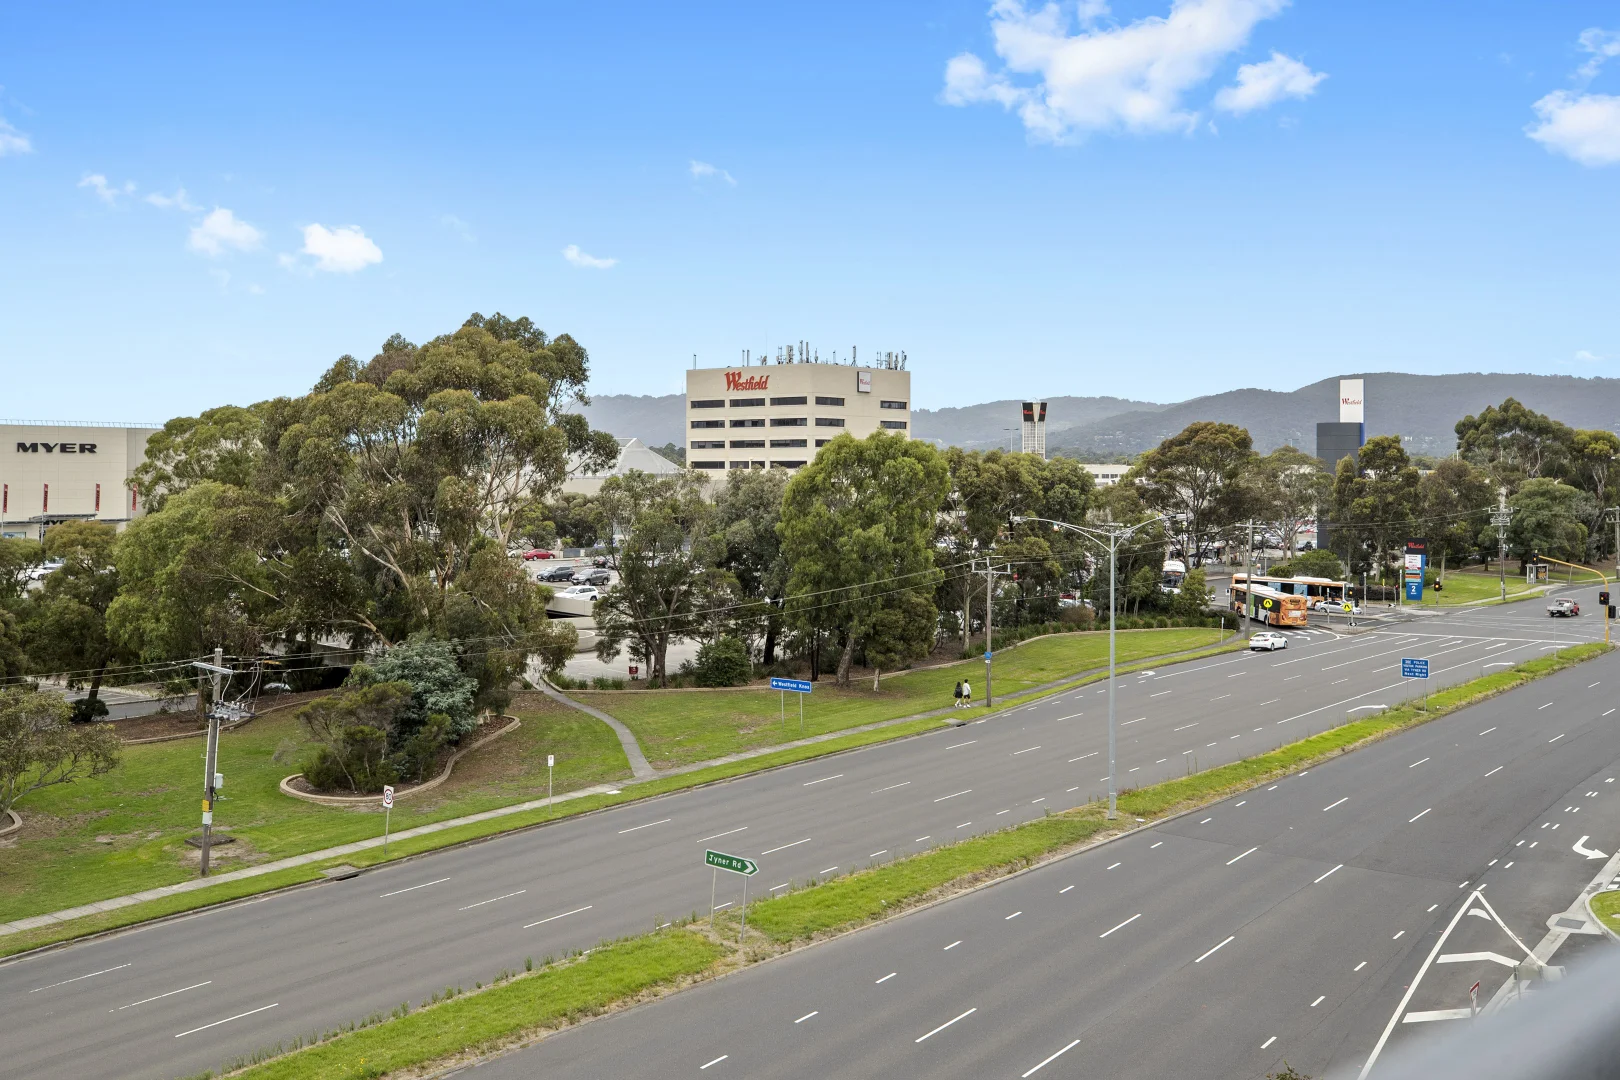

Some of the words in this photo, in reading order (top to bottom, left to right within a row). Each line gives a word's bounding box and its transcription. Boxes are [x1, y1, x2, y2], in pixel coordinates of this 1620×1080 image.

[724, 371, 770, 391] Westfield
[17, 442, 97, 453] MYER
[732, 860, 742, 869] Rd
